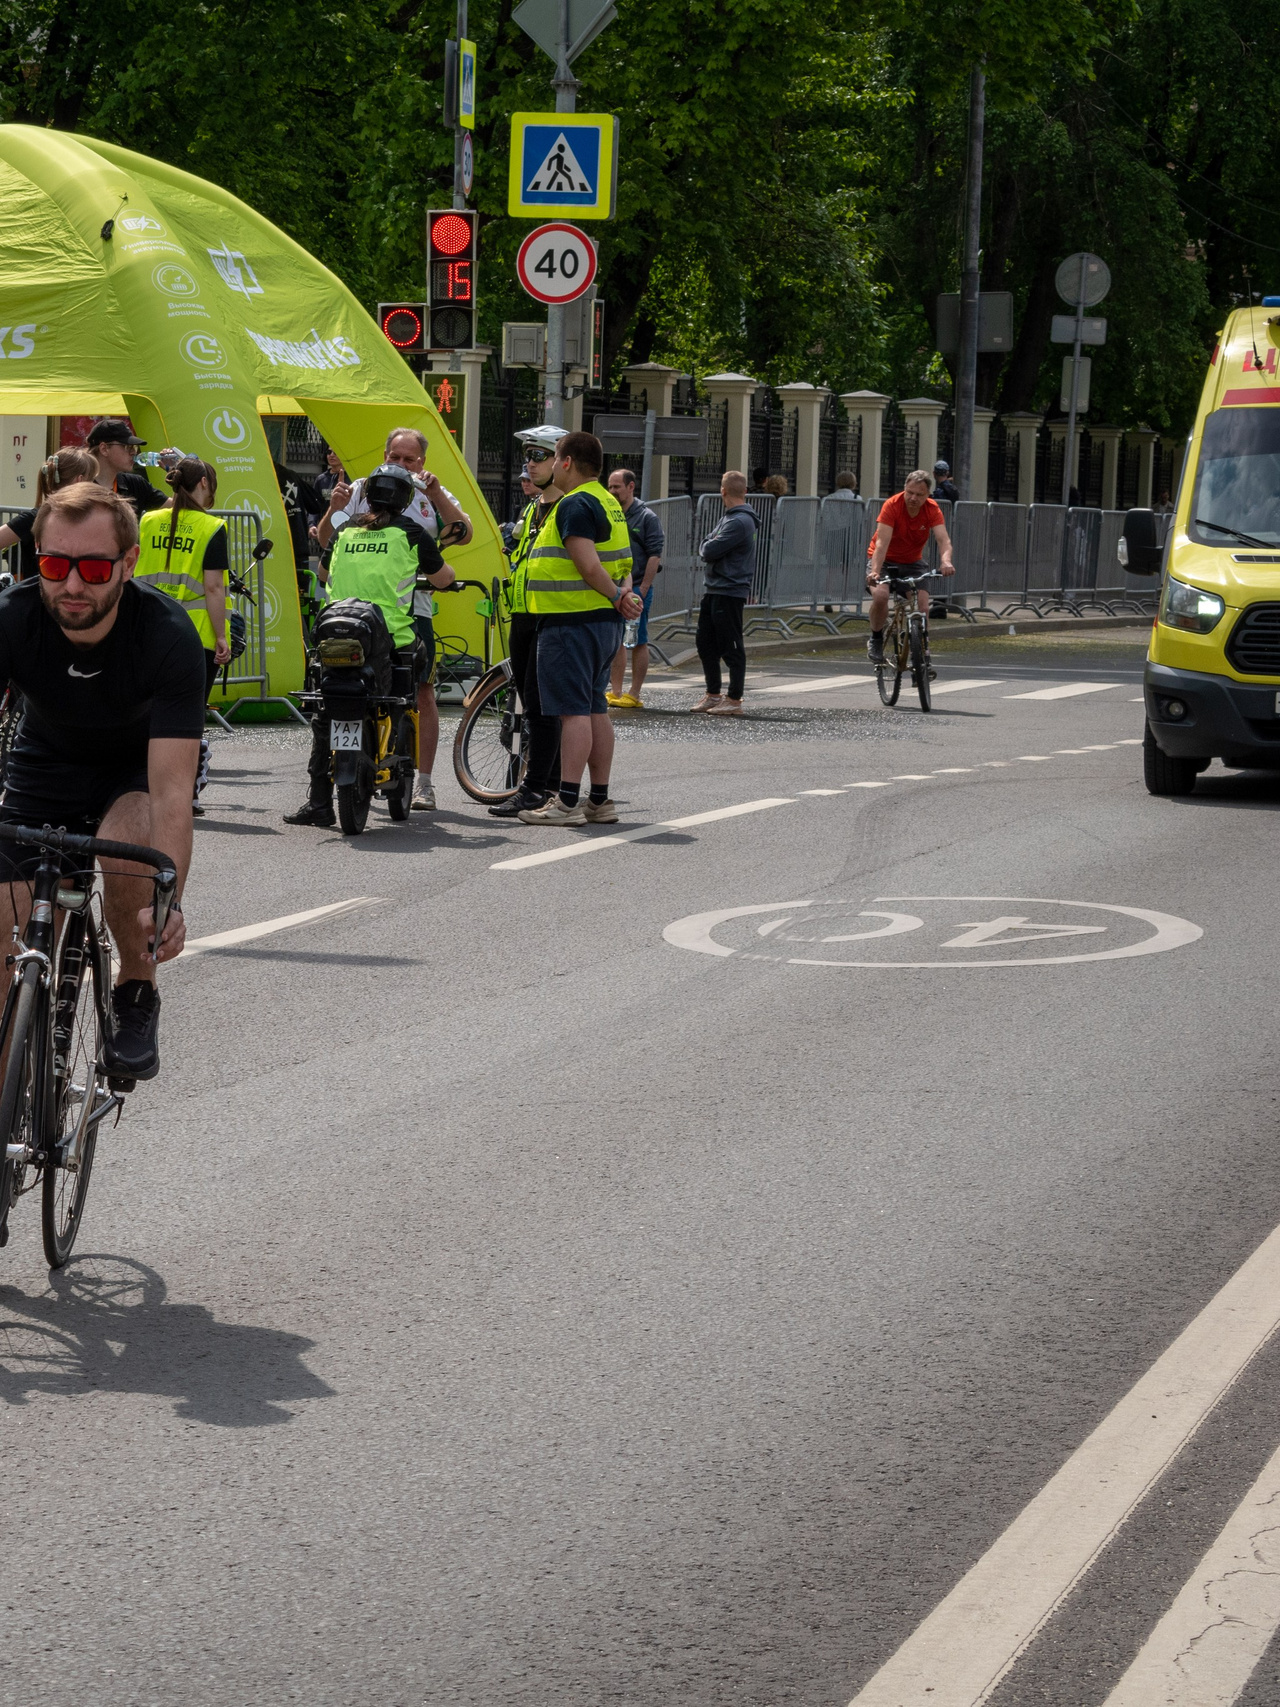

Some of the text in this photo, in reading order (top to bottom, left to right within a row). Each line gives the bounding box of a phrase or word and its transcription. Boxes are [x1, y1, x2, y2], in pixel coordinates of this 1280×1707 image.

[534, 248, 580, 280] 40
[448, 262, 471, 300] 15
[168, 302, 206, 311] Высокая
[168, 310, 212, 319] мощность
[193, 372, 232, 381] Быстрая
[199, 383, 234, 391] зарядка
[15, 453, 22, 463] 9
[216, 456, 256, 464] Быстрый
[224, 465, 254, 473] запуск
[344, 542, 389, 554] ЦОВД
[6, 711, 21, 753] MAXXIS
